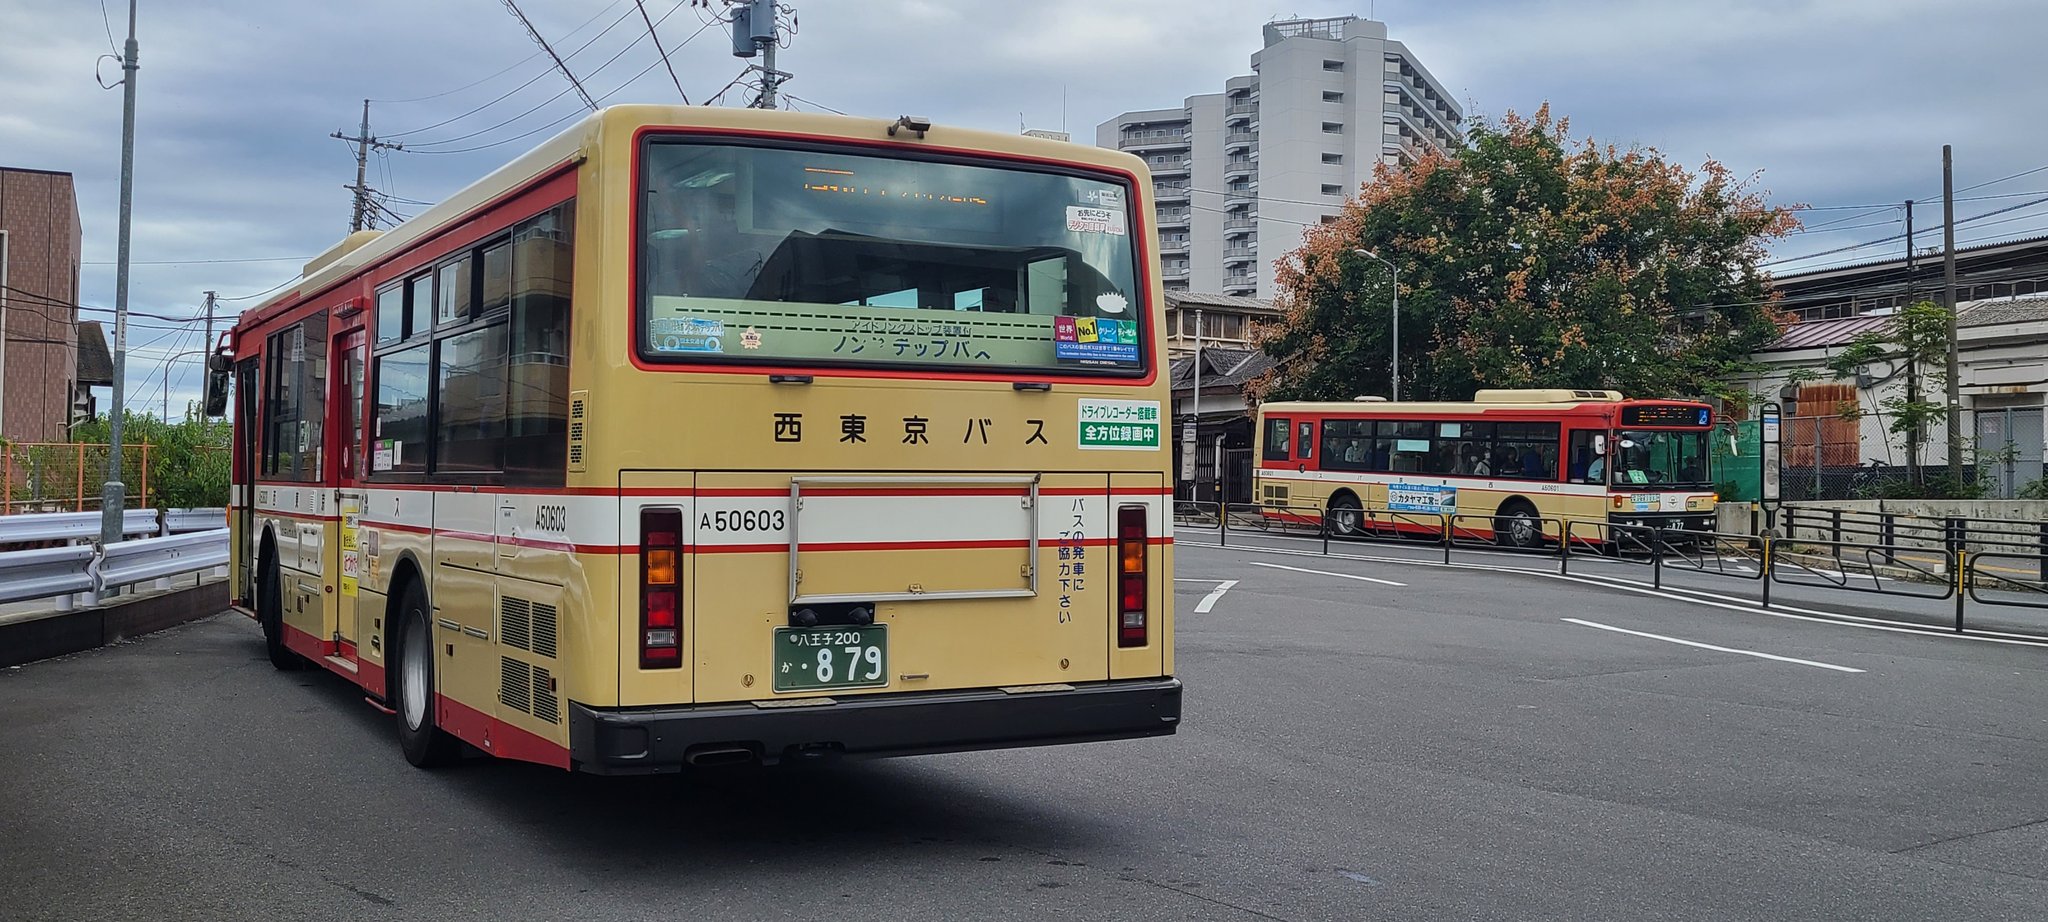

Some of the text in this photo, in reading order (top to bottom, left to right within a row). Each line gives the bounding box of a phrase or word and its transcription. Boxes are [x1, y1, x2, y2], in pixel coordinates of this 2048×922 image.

[1059, 324, 1073, 334] 世界
[1078, 321, 1096, 337] No.1
[1098, 327, 1117, 336] クリーン
[1081, 404, 1158, 421] ドライブレコーダー搭載車
[773, 413, 1049, 445] 西東京バス
[1085, 424, 1155, 442] 全方位録画中
[535, 505, 566, 532] A50603
[700, 510, 785, 532] A50603
[1072, 498, 1085, 592] バスの発車に
[1058, 530, 1072, 624] ご協力下さい
[798, 632, 861, 647] 八王子200
[781, 661, 793, 674] か
